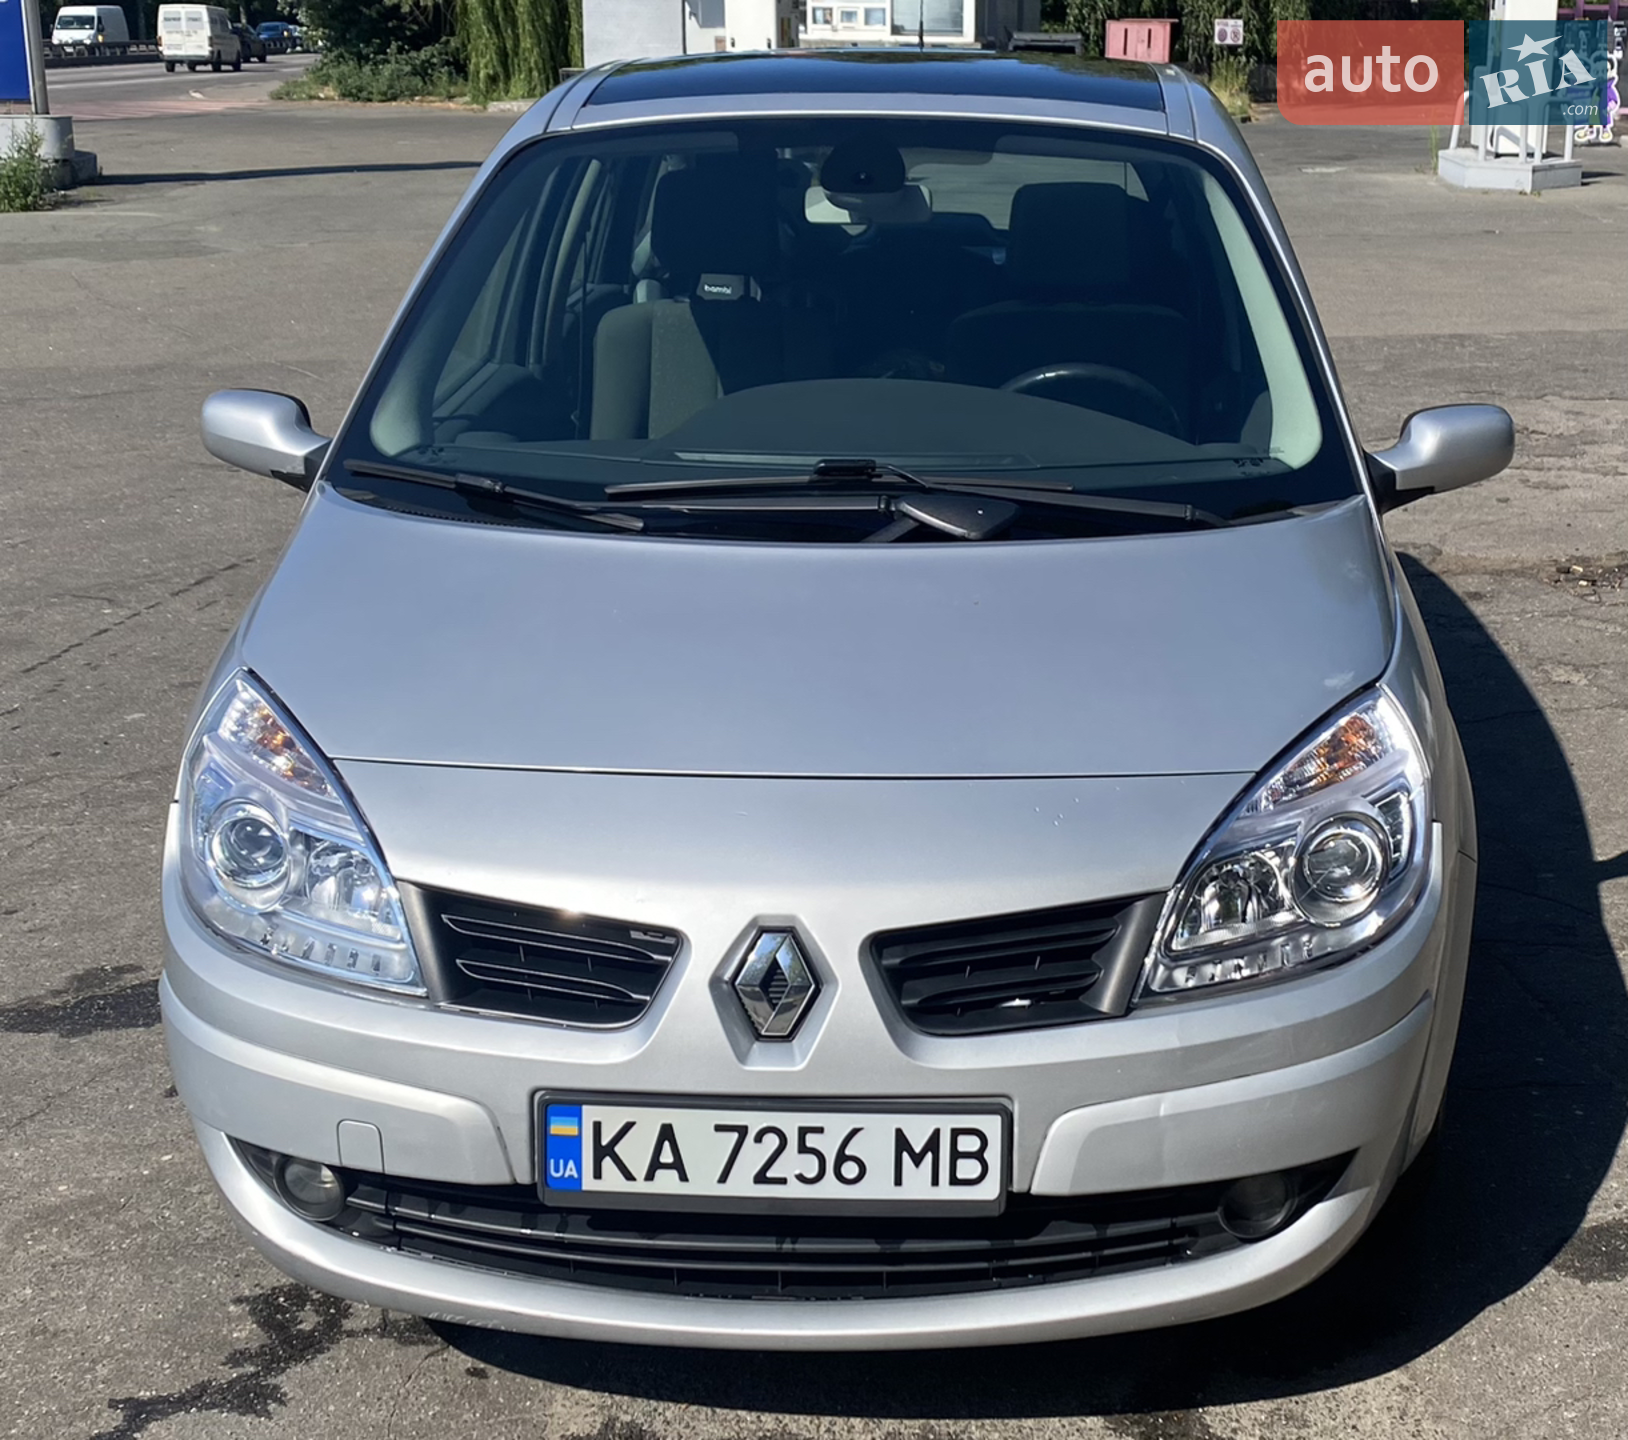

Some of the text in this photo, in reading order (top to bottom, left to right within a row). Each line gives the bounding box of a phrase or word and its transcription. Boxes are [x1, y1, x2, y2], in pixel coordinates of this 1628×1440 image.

[550, 1158, 578, 1179] UA
[592, 1120, 989, 1187] KA 7256 MB
